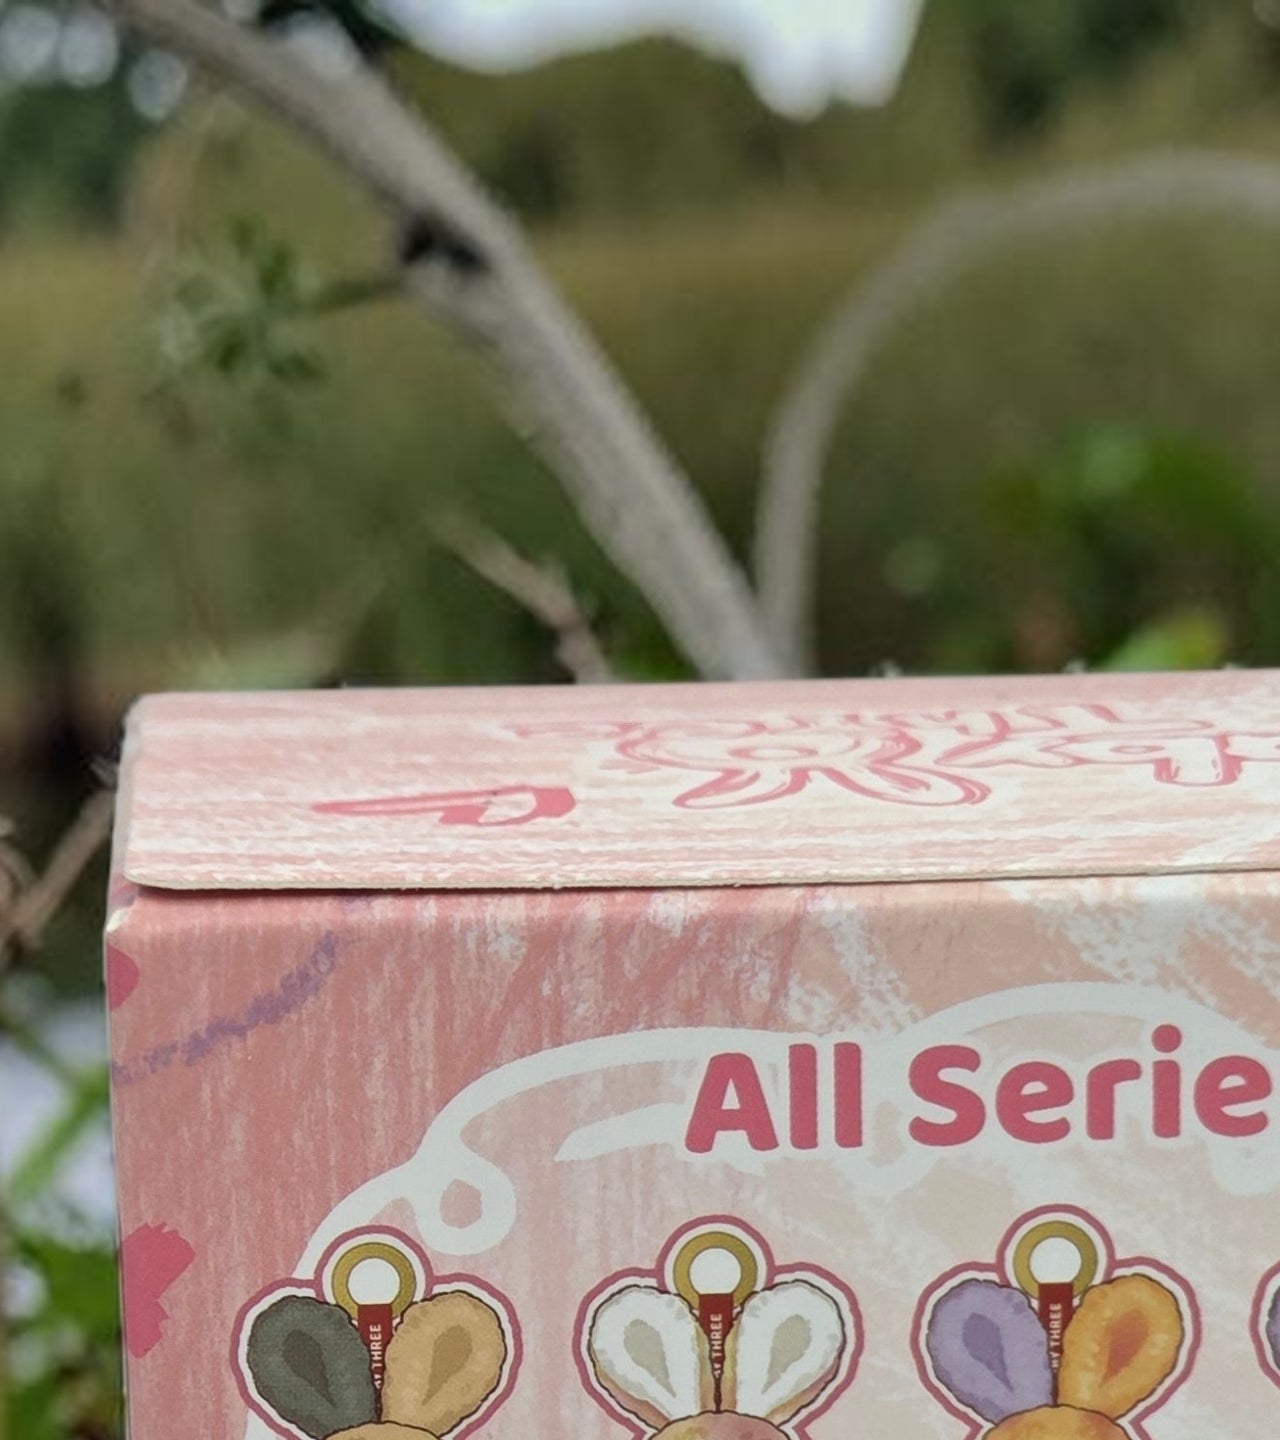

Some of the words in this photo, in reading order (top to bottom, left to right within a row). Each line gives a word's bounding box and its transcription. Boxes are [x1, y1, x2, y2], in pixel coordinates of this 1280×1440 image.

[685, 1041, 863, 1154] All
[370, 1324, 383, 1368] THREE
[711, 1314, 723, 1358] THREE
[1049, 1303, 1061, 1348] THREE
